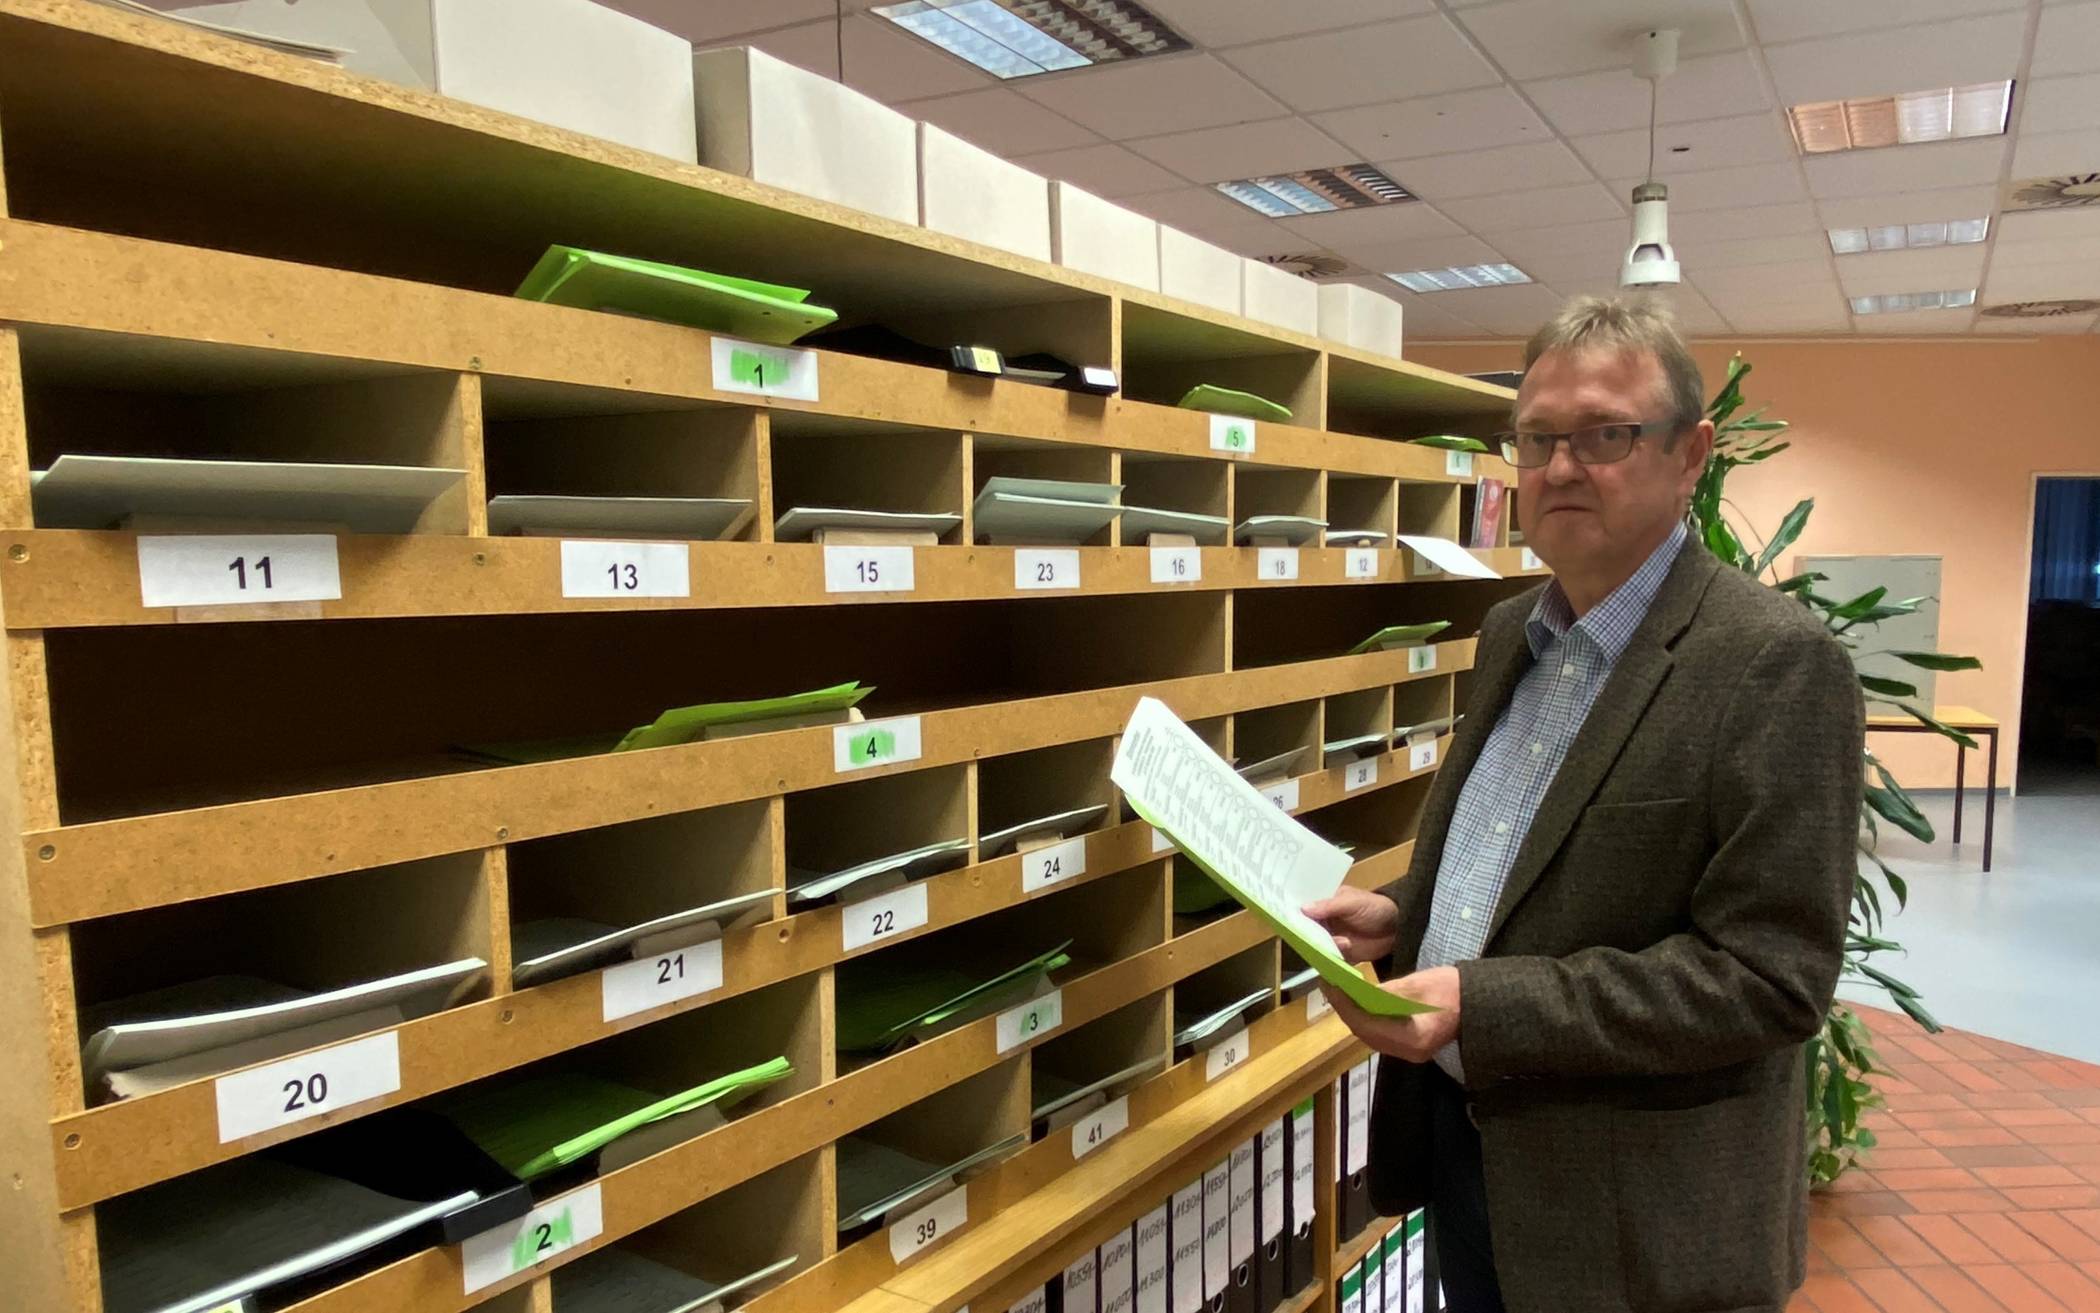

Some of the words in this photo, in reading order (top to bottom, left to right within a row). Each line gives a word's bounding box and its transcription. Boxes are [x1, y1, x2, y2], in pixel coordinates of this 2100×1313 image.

[753, 363, 763, 388] 1
[1232, 430, 1240, 449] 5
[229, 556, 272, 589] 11
[607, 563, 638, 590] 13
[858, 561, 880, 583] 15
[1037, 563, 1054, 582] 23
[1171, 558, 1185, 576] 16
[1274, 560, 1286, 576] 18
[866, 736, 878, 758] 4
[1044, 857, 1061, 879] 24
[872, 910, 894, 936] 22
[657, 953, 685, 985] 21
[1029, 1012, 1039, 1031] 3
[1224, 1048, 1236, 1067] 30
[283, 1073, 328, 1113] 20
[1088, 1123, 1103, 1144] 41
[535, 1223, 553, 1252] 2
[917, 1218, 936, 1245] 39
